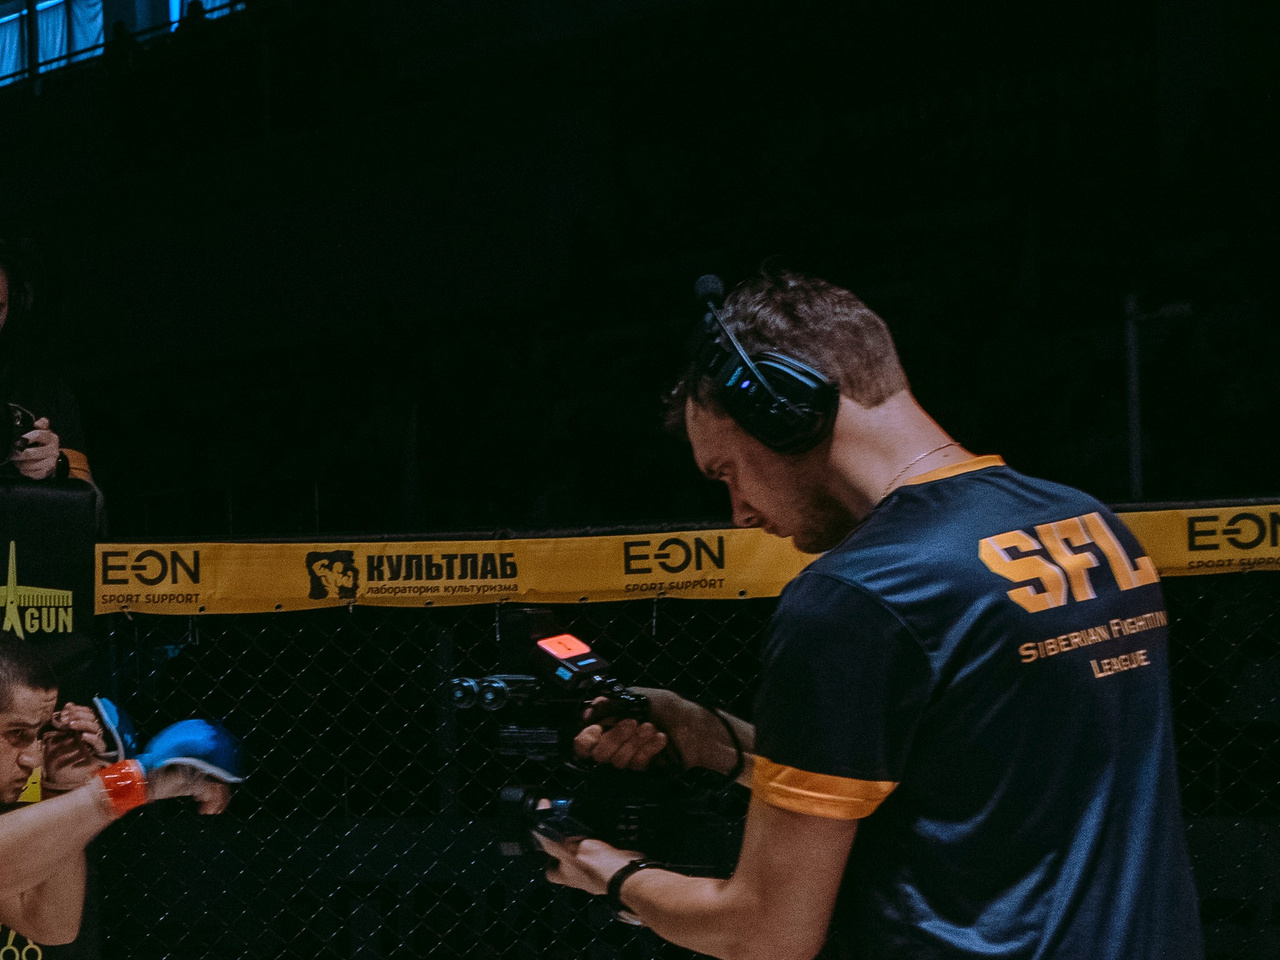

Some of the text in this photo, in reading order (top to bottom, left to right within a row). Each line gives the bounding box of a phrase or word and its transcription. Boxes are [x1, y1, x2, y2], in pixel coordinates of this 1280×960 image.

[102, 549, 200, 586] EON
[366, 552, 518, 582] КУЛЬТЛАБ
[624, 536, 724, 574] EON
[978, 511, 1161, 613] SFL
[101, 593, 200, 604] SPORT SUPPORT
[366, 583, 518, 596] лаборатория культуризма
[624, 578, 724, 593] SPORT SUPPORT
[24, 607, 74, 634] GUN
